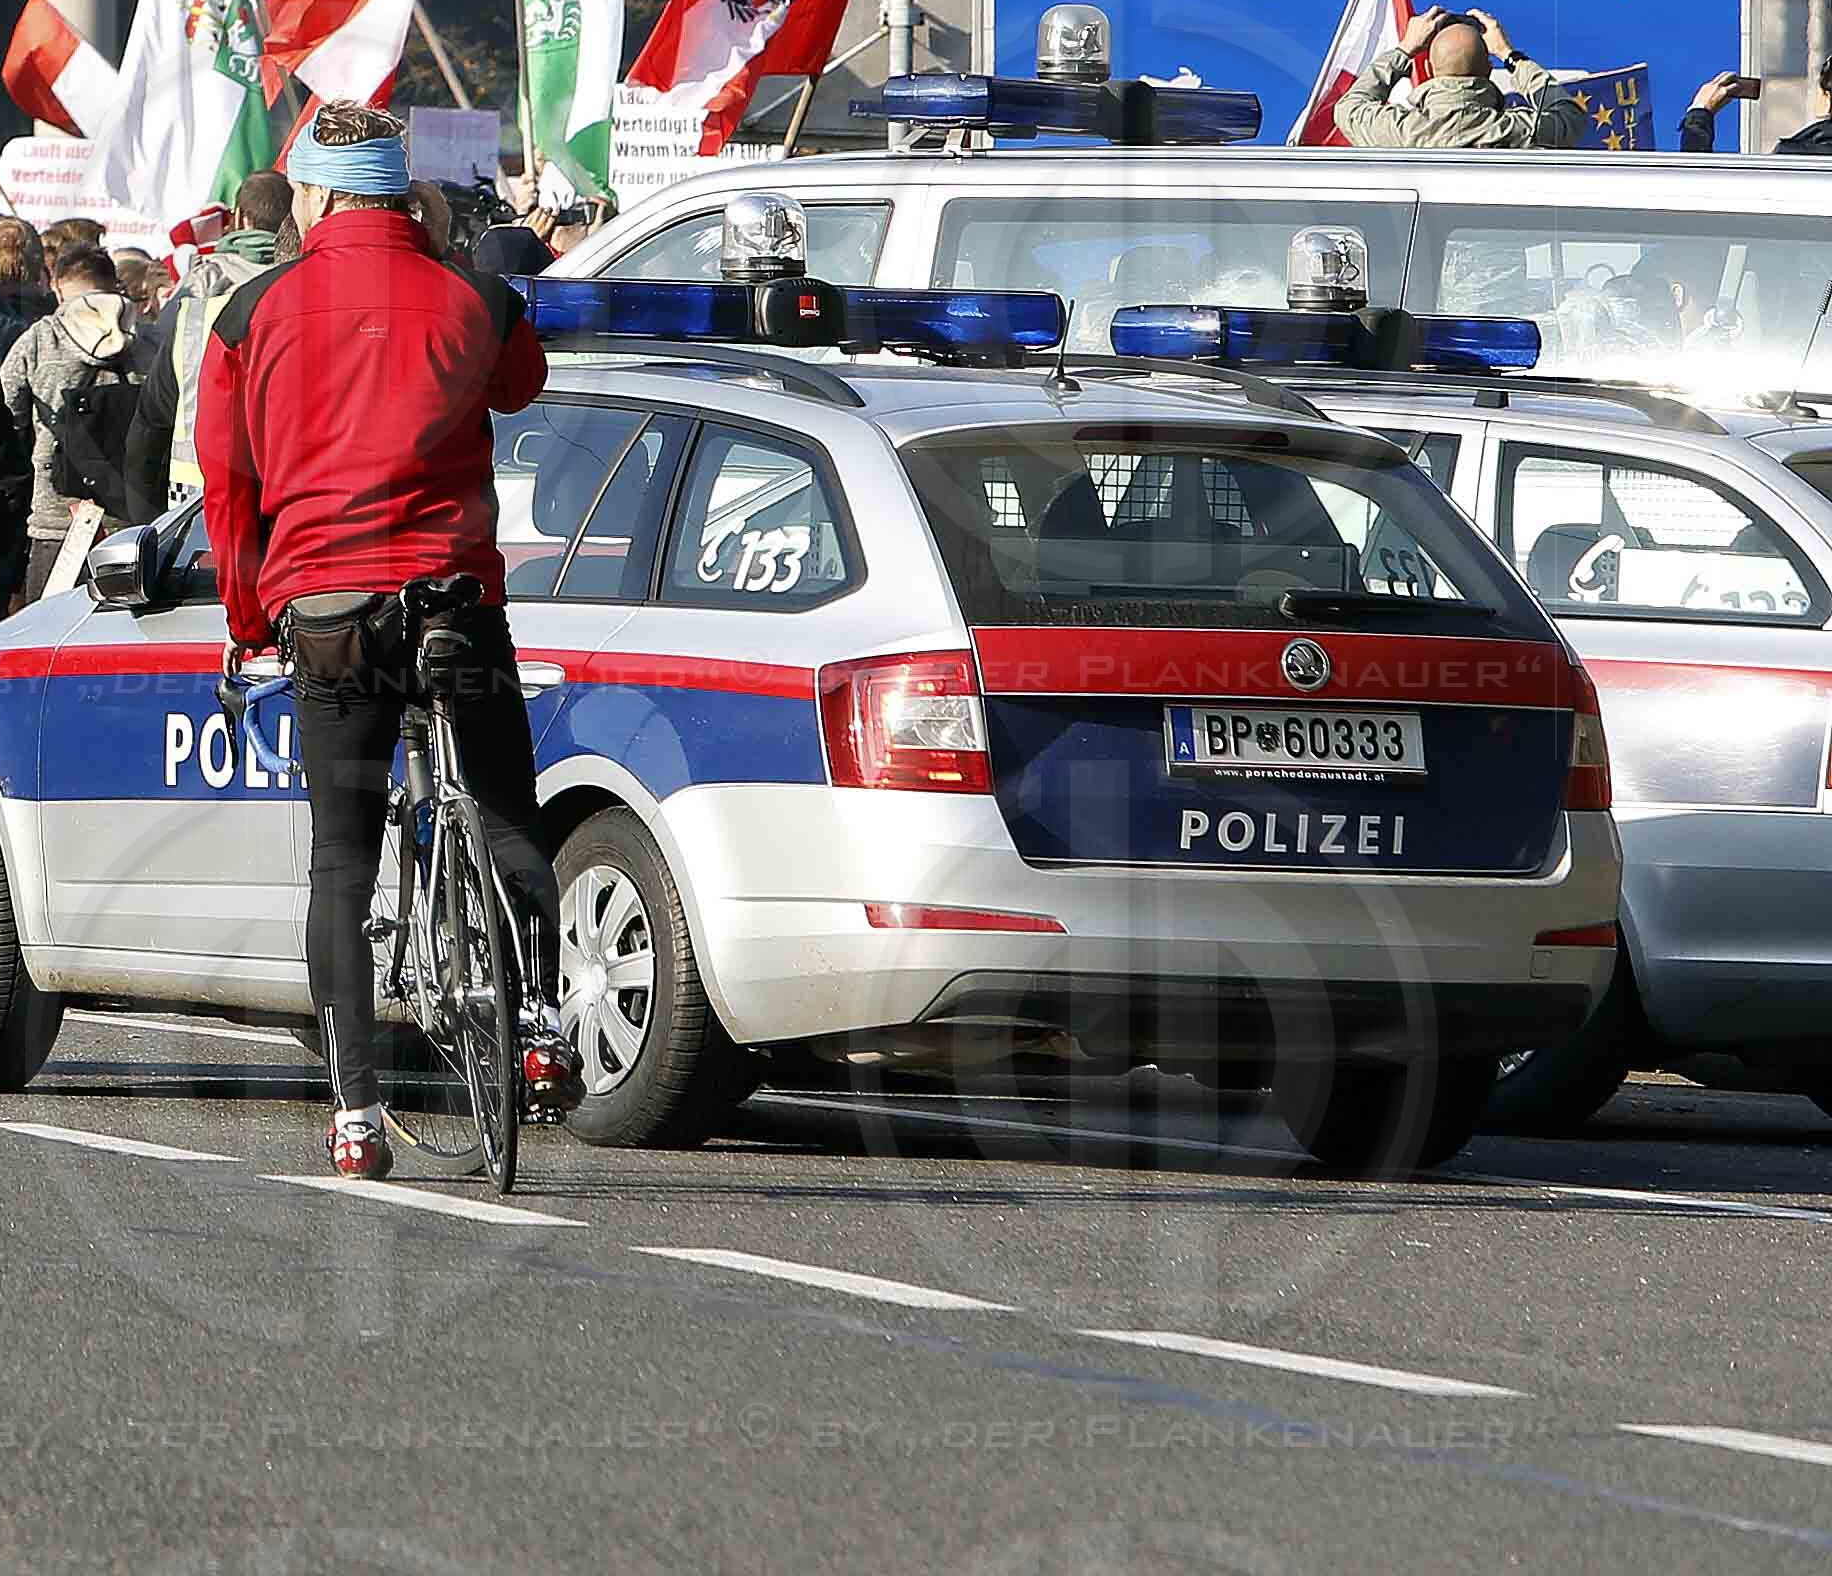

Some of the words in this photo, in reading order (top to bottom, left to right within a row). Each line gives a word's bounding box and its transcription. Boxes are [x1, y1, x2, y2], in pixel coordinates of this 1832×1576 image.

[733, 526, 811, 593] 133
[1178, 742, 1191, 755] A
[1204, 715, 1253, 758] BP
[1283, 717, 1405, 762] 60333
[1180, 810, 1404, 855] POLIZEI
